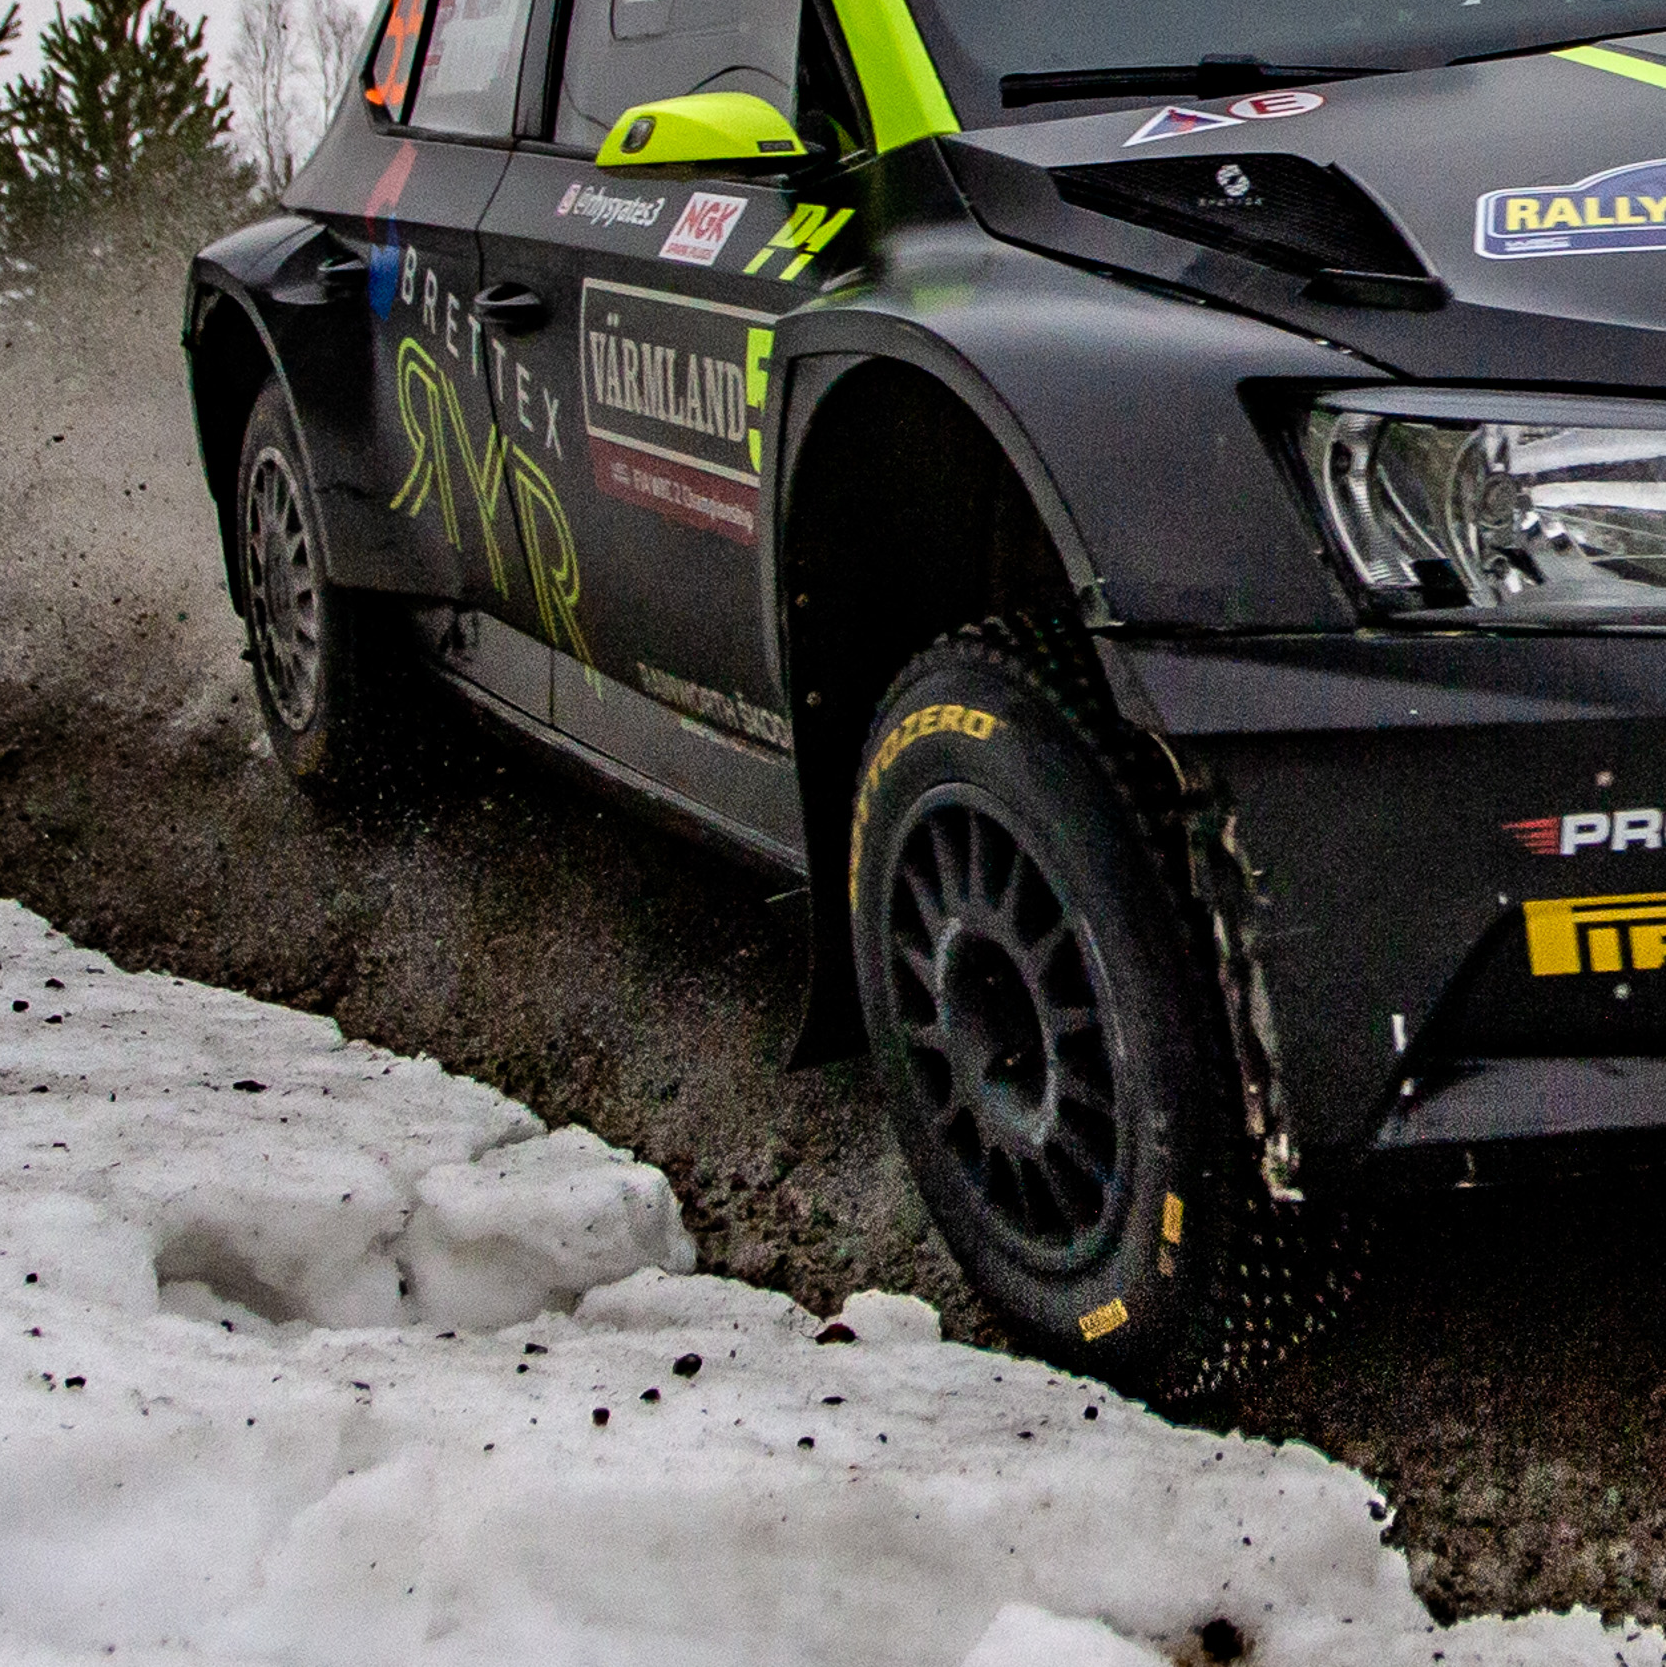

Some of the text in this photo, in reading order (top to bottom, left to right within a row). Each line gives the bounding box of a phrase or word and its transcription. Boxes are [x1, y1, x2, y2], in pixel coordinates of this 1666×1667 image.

[675, 198, 739, 243] NGK
[400, 243, 565, 462] BRETTEX
[589, 311, 747, 443] VÄRMLAND
